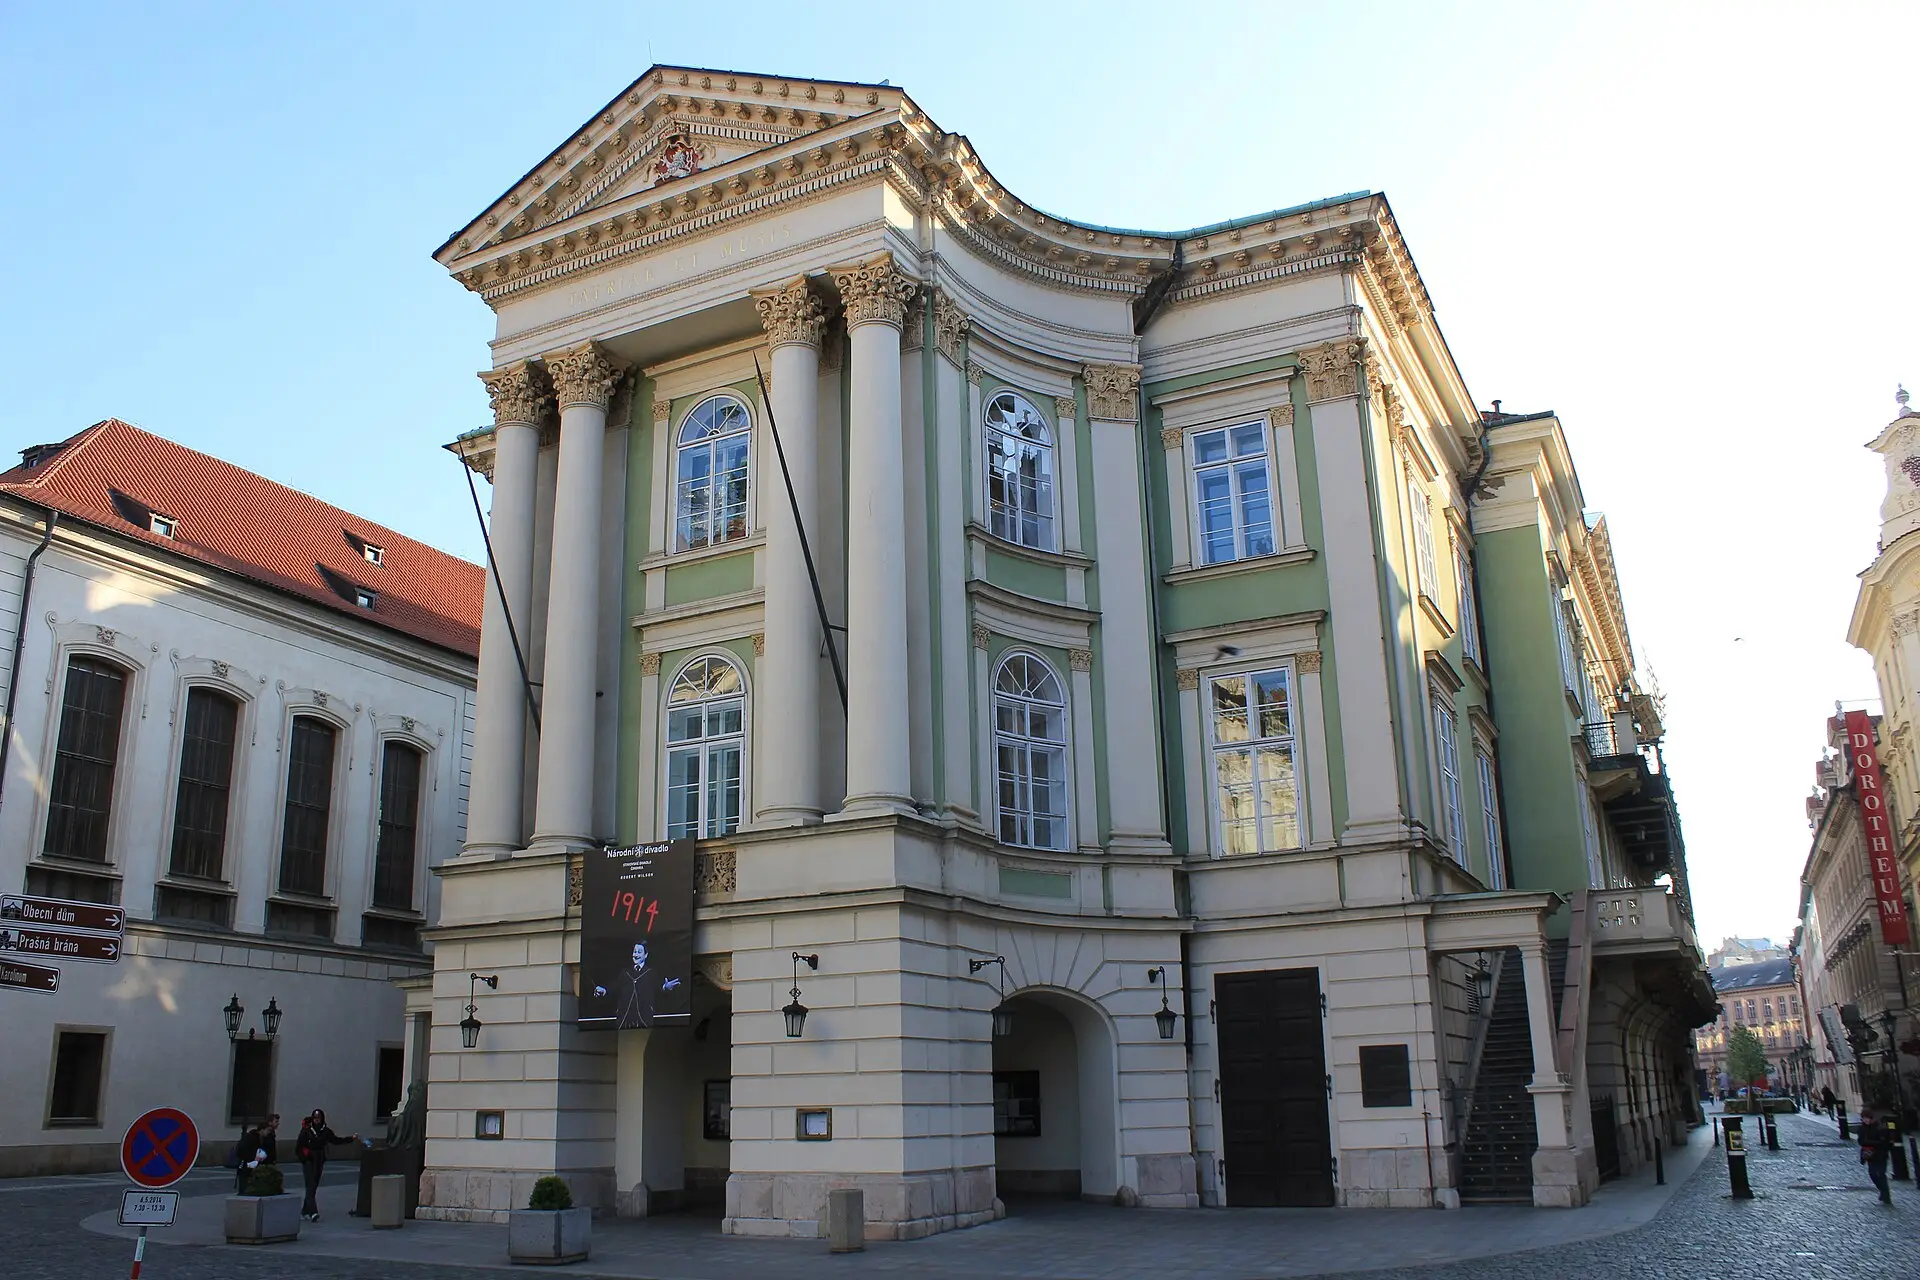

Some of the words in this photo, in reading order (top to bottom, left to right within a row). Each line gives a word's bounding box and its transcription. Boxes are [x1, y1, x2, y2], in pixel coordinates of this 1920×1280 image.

[1899, 499, 1920, 512] 19
[1852, 732, 1901, 915] DOROTHEUM
[607, 847, 634, 858] Národní
[644, 844, 669, 854] divadlo
[23, 903, 53, 920] Obecní
[56, 907, 75, 922] dům
[611, 890, 659, 932] 1914
[19, 934, 50, 951] Prašná
[54, 937, 79, 953] brána
